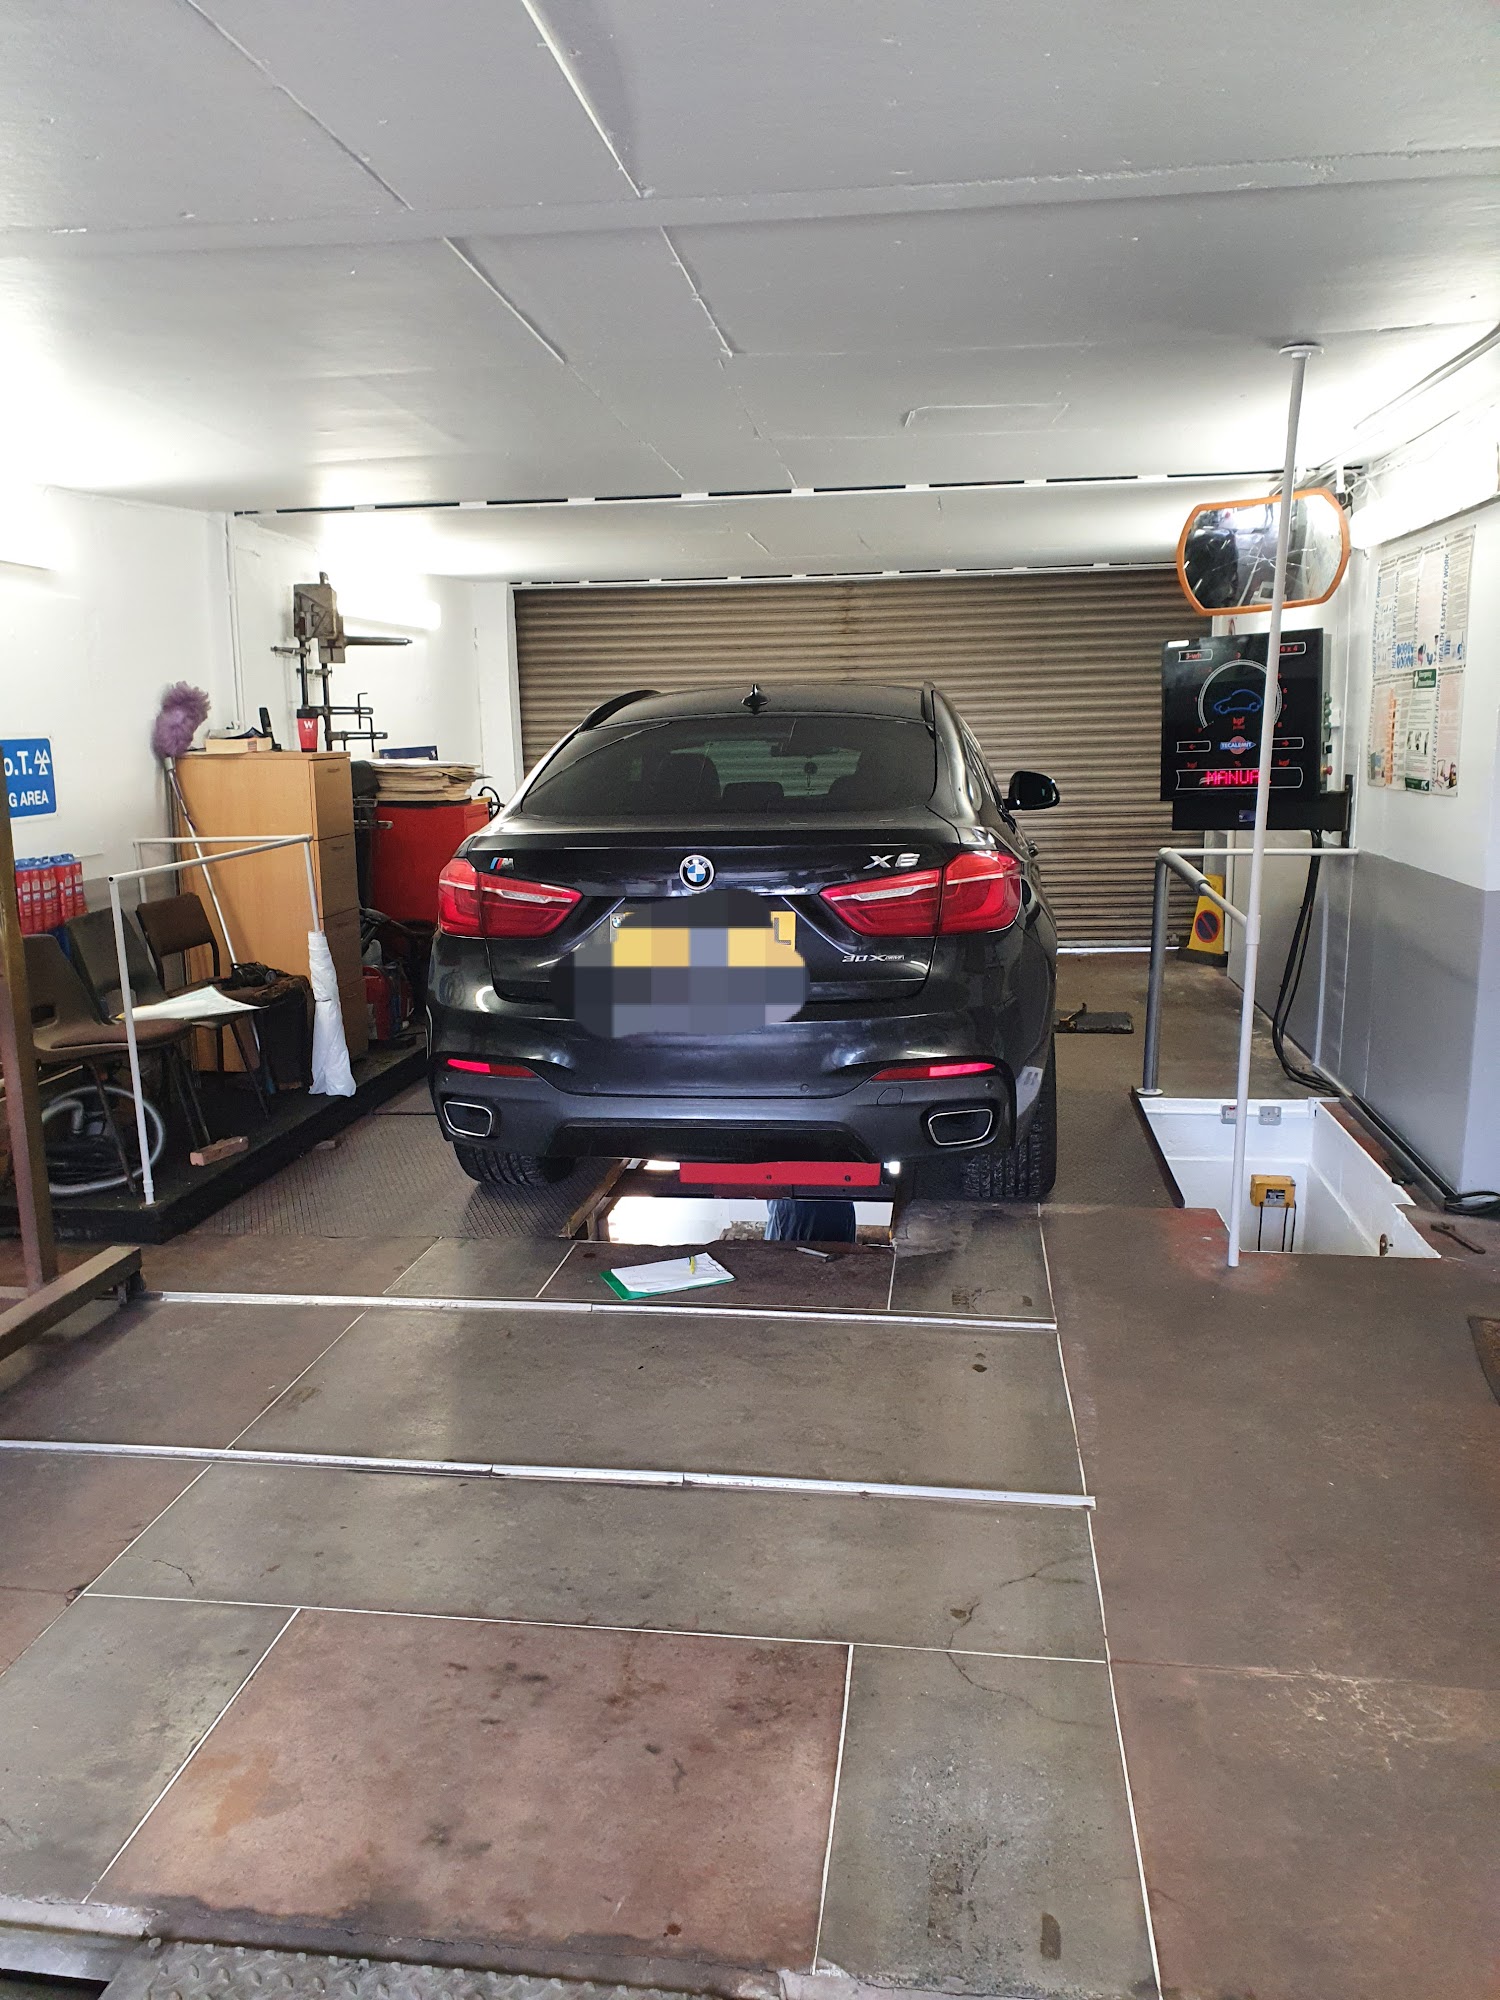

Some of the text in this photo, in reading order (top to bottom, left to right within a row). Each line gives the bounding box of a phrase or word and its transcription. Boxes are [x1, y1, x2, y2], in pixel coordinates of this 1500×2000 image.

[303, 720, 314, 729] W
[1207, 769, 1271, 785] MANUA
[8, 790, 49, 808] G AREA
[863, 853, 920, 869] X6
